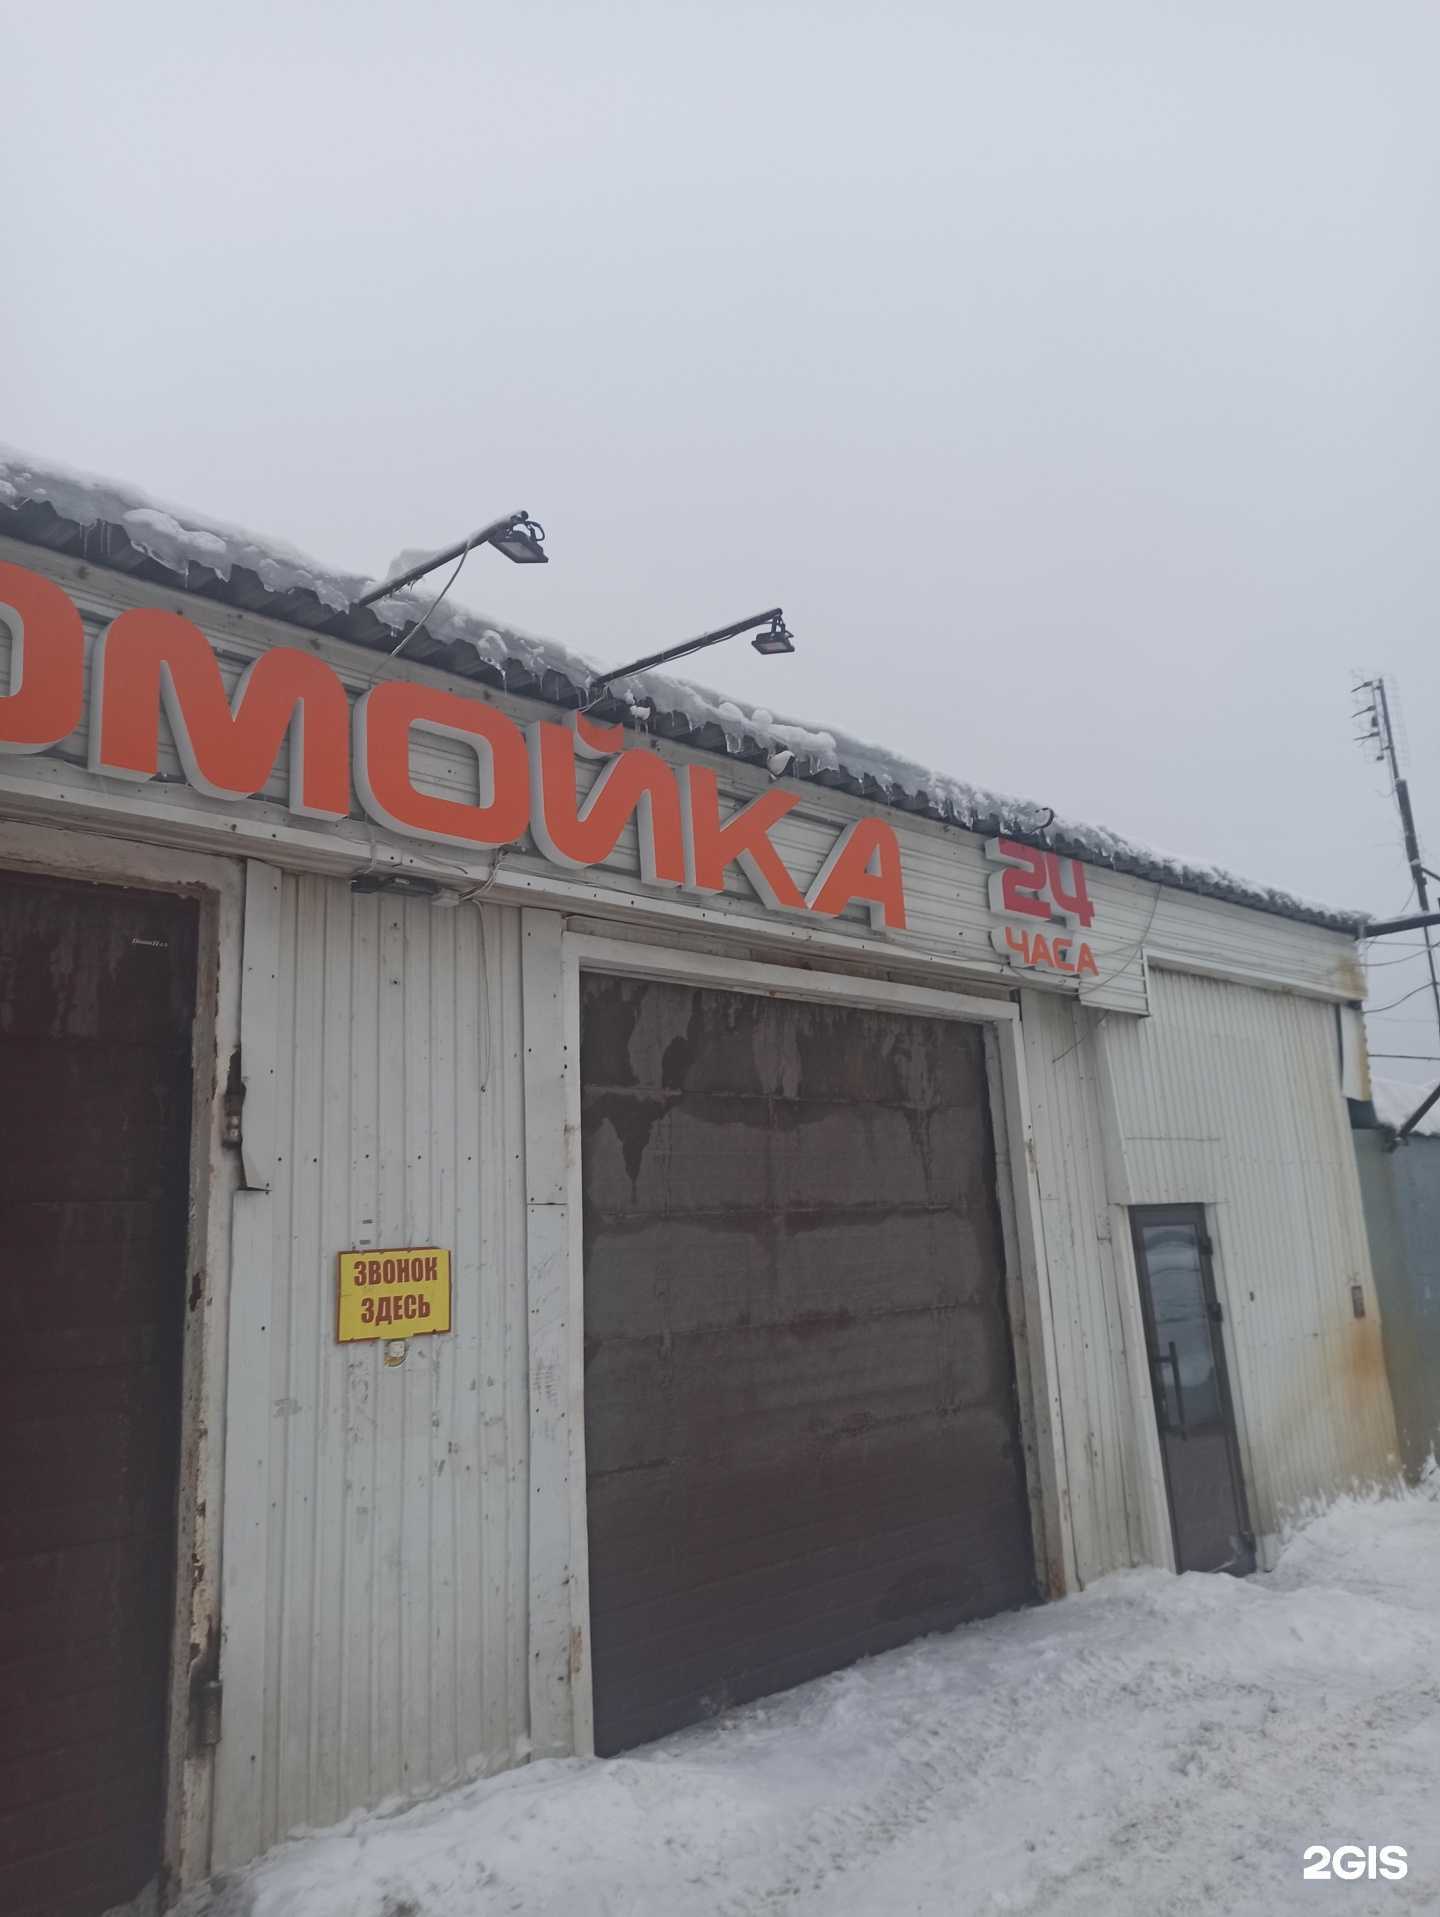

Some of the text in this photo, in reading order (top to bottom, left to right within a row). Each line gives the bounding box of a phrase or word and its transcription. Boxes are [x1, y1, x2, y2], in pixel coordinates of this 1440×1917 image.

[997, 837, 1095, 928] 24
[1004, 926, 1099, 977] ЧАСА
[353, 1257, 438, 1286] ЗВОНОК
[361, 1294, 431, 1326] ЗДЕСЬ
